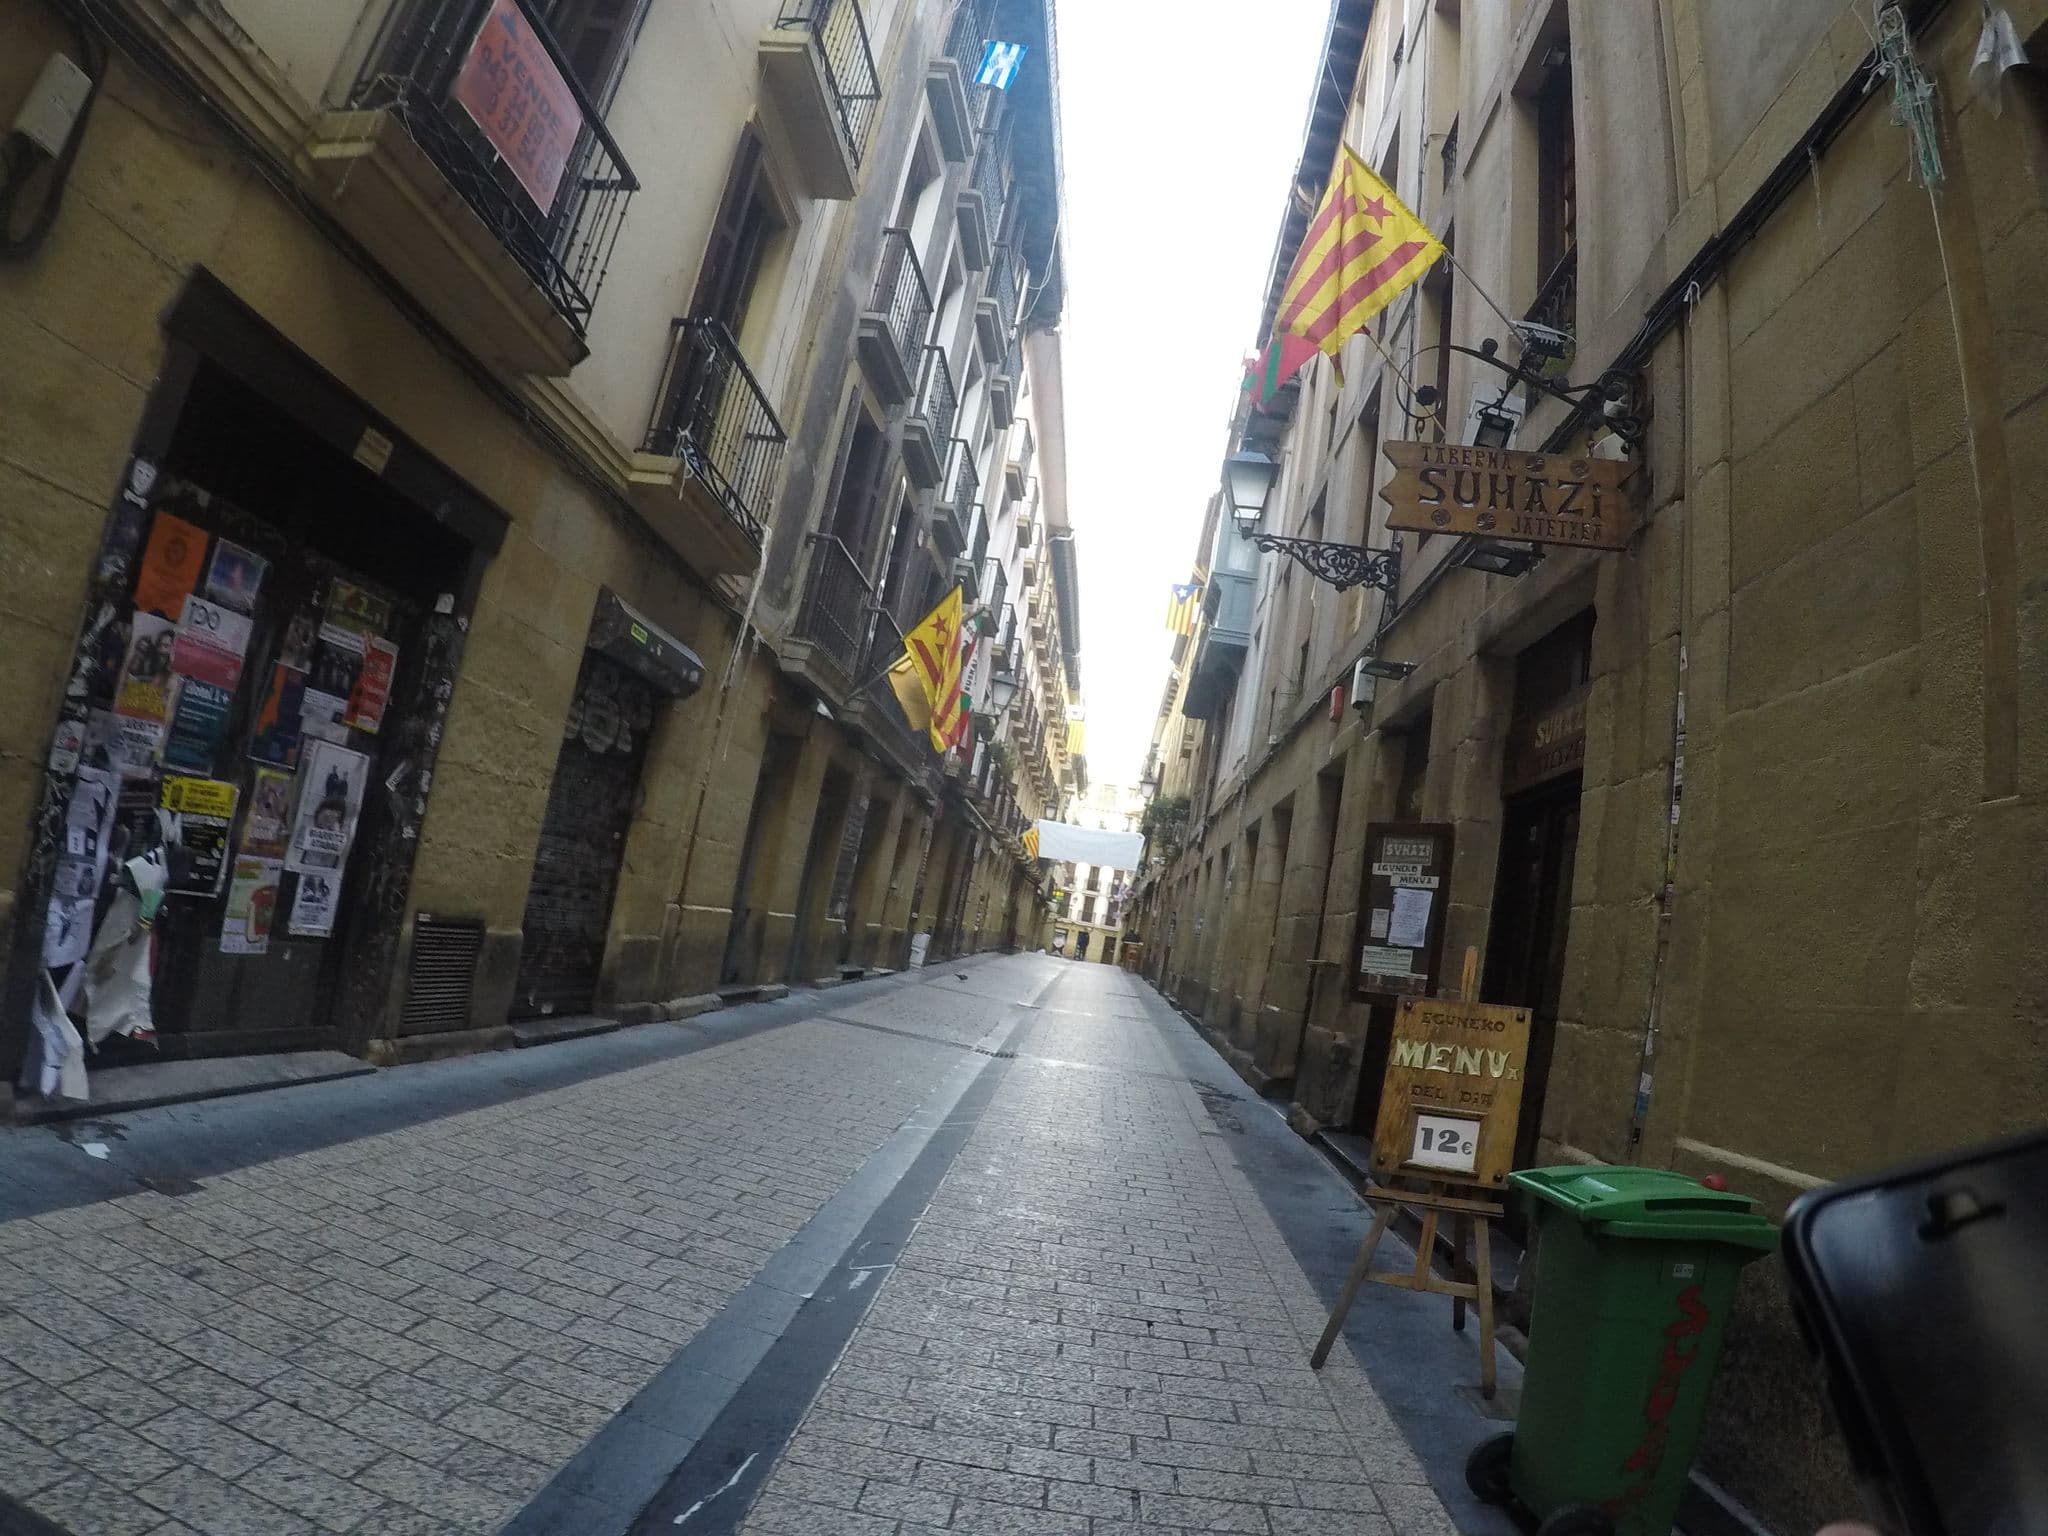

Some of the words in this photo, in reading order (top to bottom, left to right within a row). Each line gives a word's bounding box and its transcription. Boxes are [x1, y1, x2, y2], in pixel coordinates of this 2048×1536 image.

[477, 42, 509, 94] 943
[500, 39, 563, 136] VENDE
[1422, 445, 1512, 470] TABERNA
[1421, 1012, 1506, 1033] EGUNEKO
[1411, 1085, 1445, 1100] DEL
[1420, 1127, 1474, 1156] 12€
